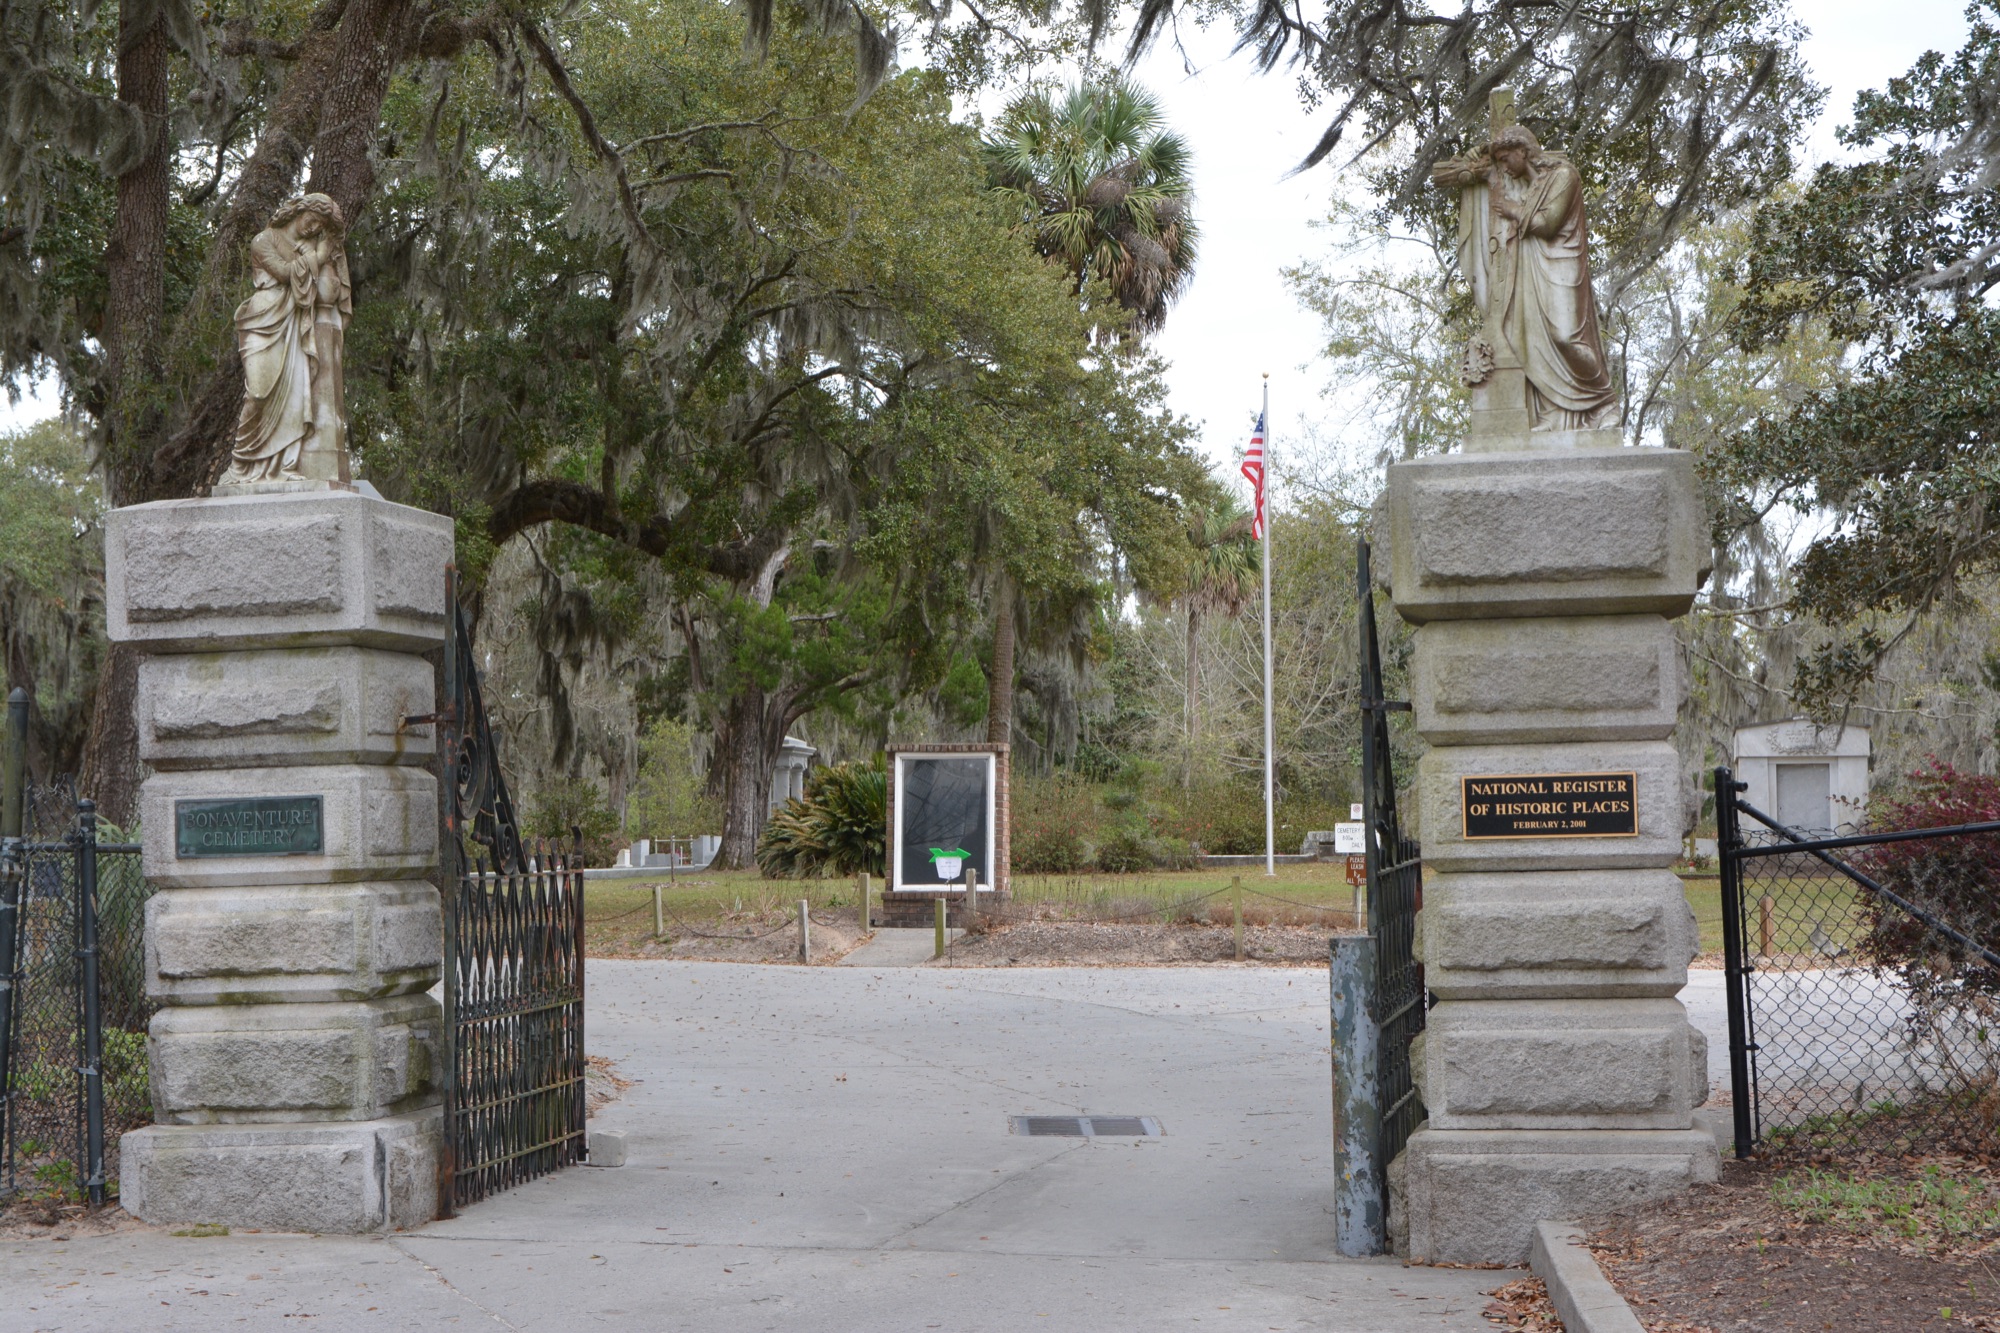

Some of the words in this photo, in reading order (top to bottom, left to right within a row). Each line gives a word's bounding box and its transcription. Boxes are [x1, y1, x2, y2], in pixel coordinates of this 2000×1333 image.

[1471, 782, 1548, 795] NATIONAL
[1552, 780, 1627, 793] REGISTER
[1470, 803, 1490, 816] OF
[1496, 802, 1567, 815] HISTORIC
[1572, 801, 1630, 813] PLACES
[185, 809, 313, 828] BONAVENTURE
[1513, 821, 1559, 829] FEBRUARY
[1561, 820, 1569, 829] 2,
[1570, 820, 1587, 828] 2001
[202, 829, 297, 846] CEMETERY
